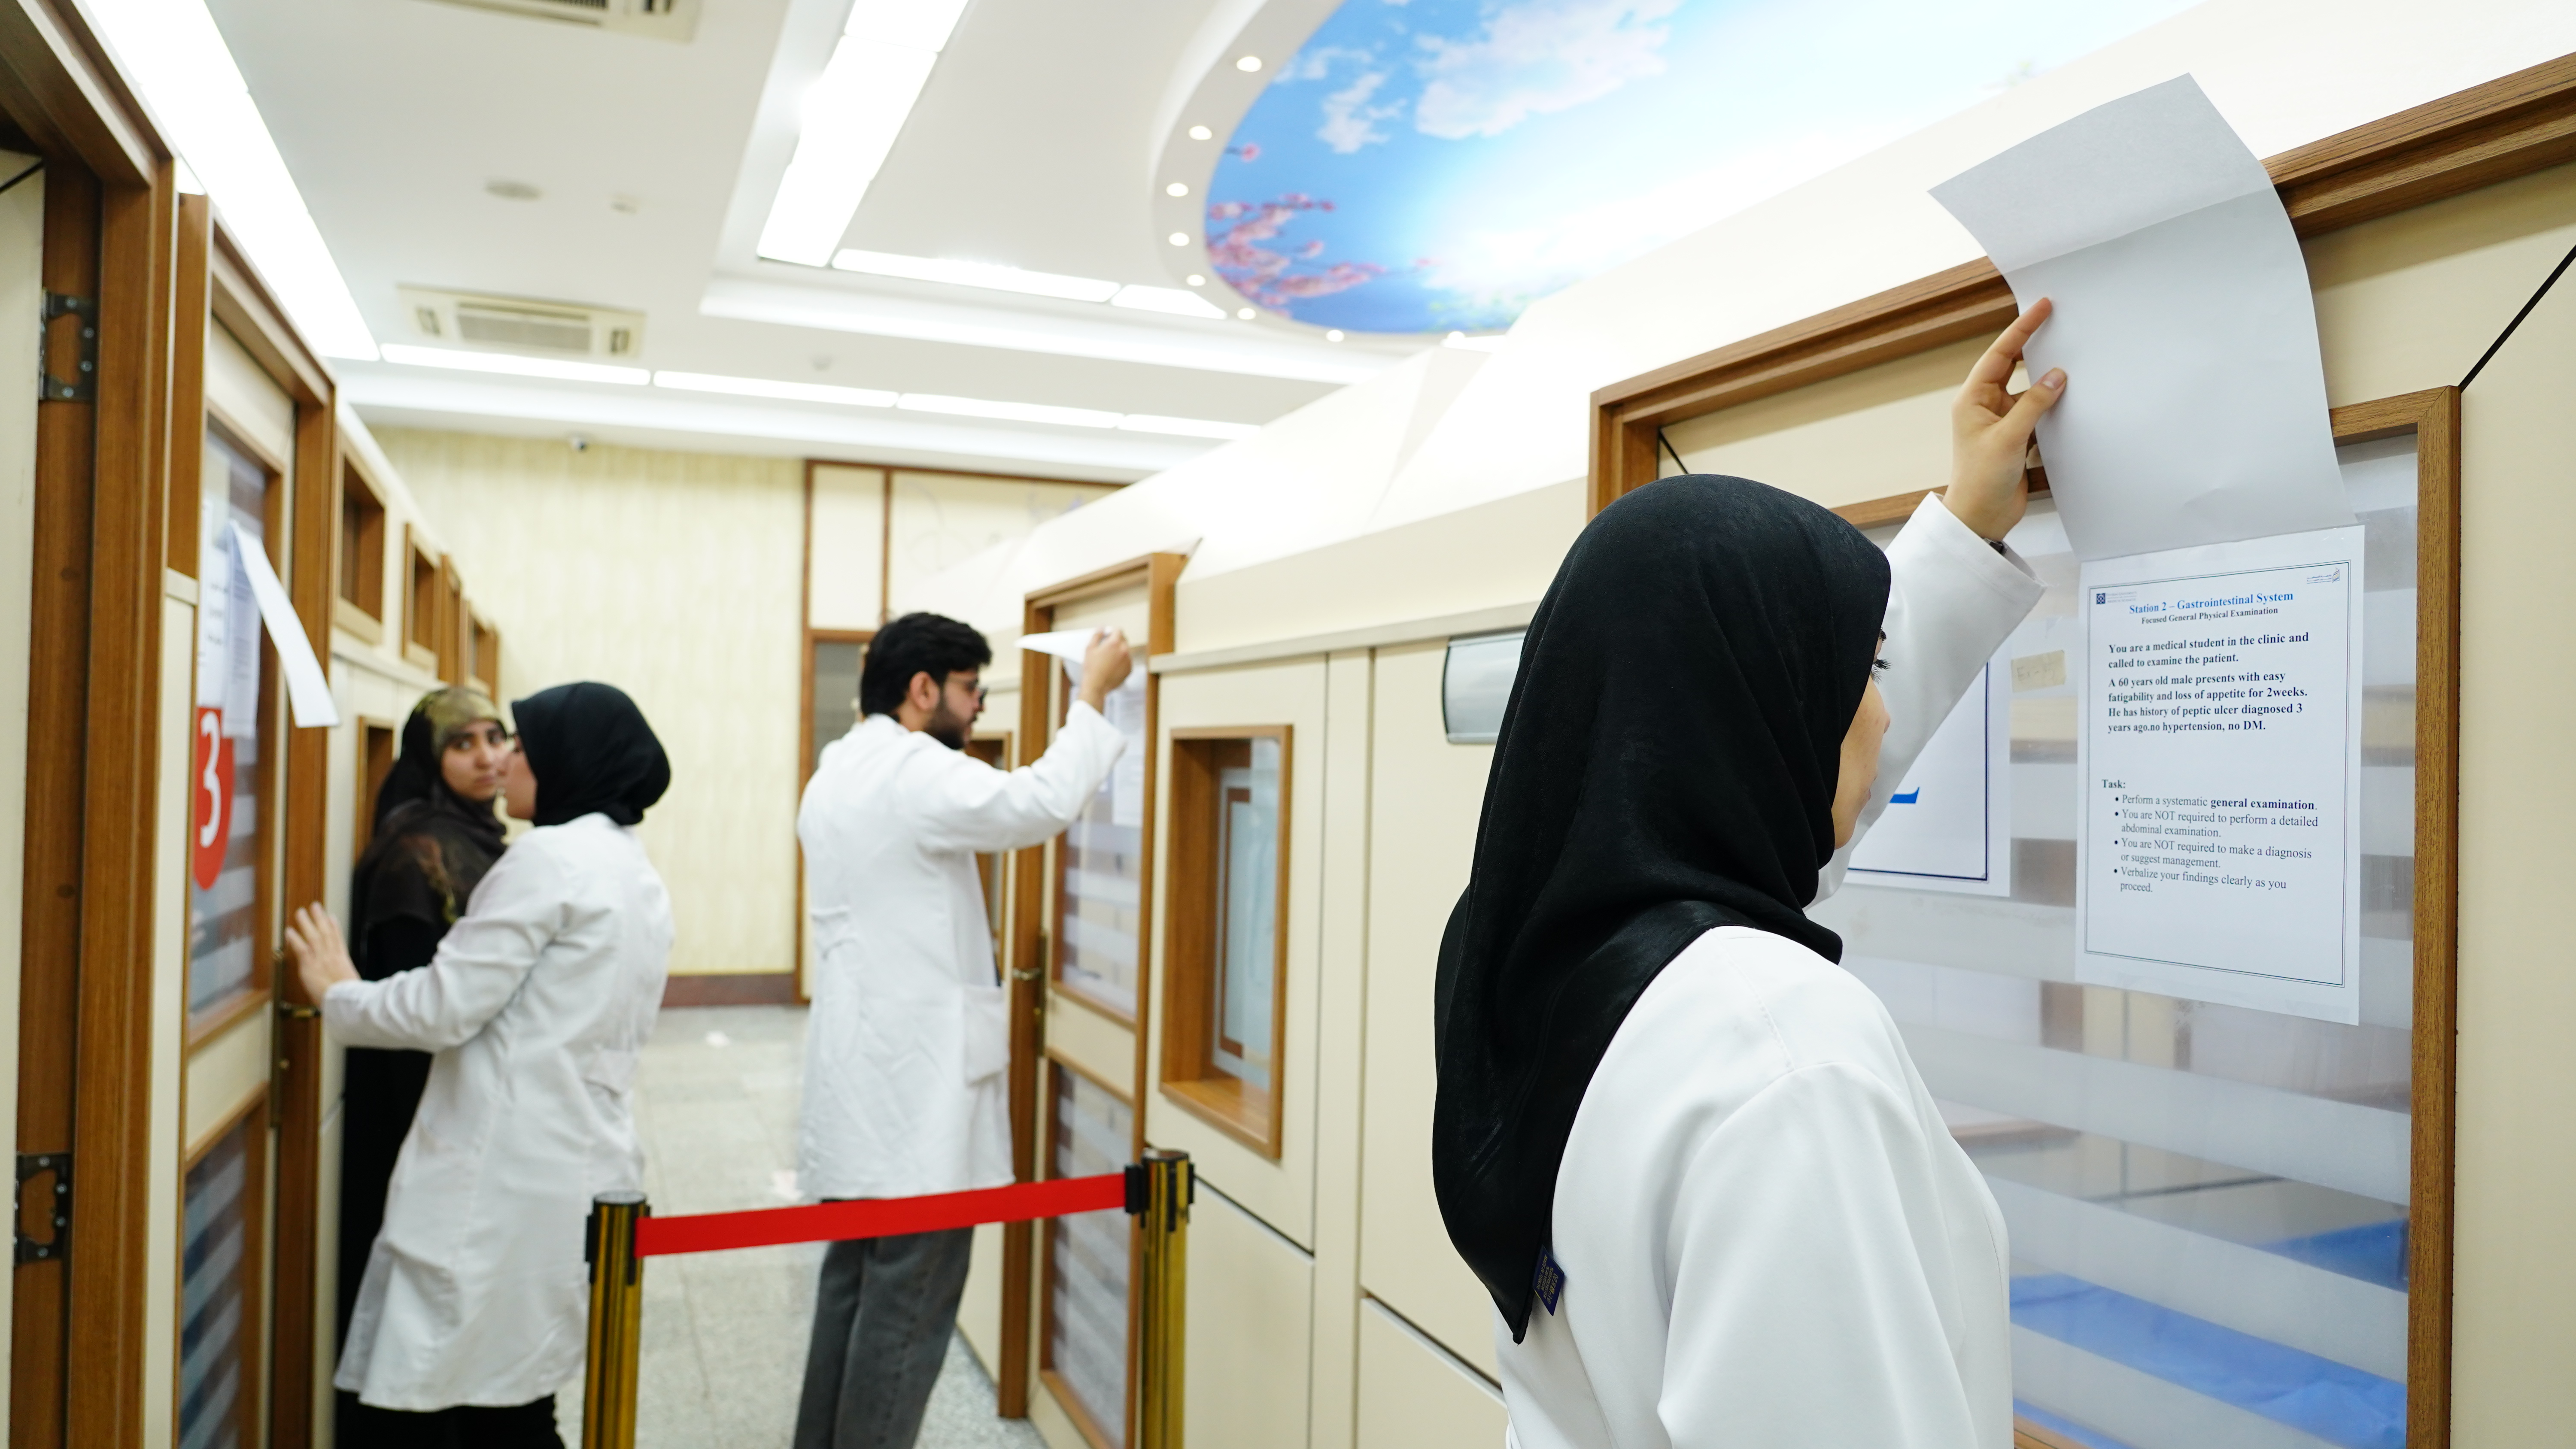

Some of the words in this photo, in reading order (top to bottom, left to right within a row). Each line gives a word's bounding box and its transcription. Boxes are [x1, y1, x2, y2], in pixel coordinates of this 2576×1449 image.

[2129, 603, 2160, 614] Station
[2161, 602, 2167, 611] 2
[2177, 594, 2254, 610] Gastrointestinal
[2256, 593, 2294, 605] System
[2142, 615, 2167, 624] Focused
[2168, 612, 2197, 622] General
[2199, 610, 2229, 621] Physical
[2230, 607, 2278, 617] Examination
[2108, 644, 2127, 654] You
[2152, 639, 2187, 651] medical
[2189, 638, 2225, 649] student
[2227, 637, 2237, 646] in
[2239, 635, 2255, 646] the
[2257, 633, 2286, 644] clinic
[2288, 631, 2309, 643] and
[2108, 658, 2134, 669] called
[2136, 659, 2145, 667] to
[2147, 656, 2183, 667] examine
[2185, 655, 2200, 664] the
[2202, 653, 2239, 666] patient.
[2108, 678, 2116, 687] A
[2118, 677, 2129, 687] 60
[2131, 679, 2153, 689] years
[2155, 675, 2169, 685] old
[2171, 674, 2193, 685] male
[2195, 674, 2236, 686] presents
[2238, 671, 2260, 682] with
[2263, 673, 2286, 683] easy
[2108, 692, 2154, 704] fatigability
[2156, 691, 2173, 700] and
[2175, 690, 2192, 700] loss
[2194, 689, 2205, 700] of
[2206, 688, 2246, 701] appetite
[2248, 688, 2264, 698] for
[2266, 686, 2308, 697] 2weeks.
[2108, 707, 2121, 717] He
[2123, 707, 2138, 717] has
[2140, 707, 2169, 718] history
[2171, 706, 2181, 715] of
[2182, 705, 2211, 718] peptic
[2214, 705, 2239, 715] ulcer
[2241, 703, 2293, 716] diagnosed
[2296, 703, 2303, 713] 3
[2108, 724, 2131, 734] years
[2162, 721, 2225, 734] hypertension,
[2243, 720, 2266, 730] DM.
[199, 711, 222, 848] 3
[2101, 779, 2126, 789] Task:
[2122, 794, 2154, 804] Perform
[2162, 796, 2208, 807] systematic
[2210, 798, 2248, 809] general
[2250, 799, 2318, 810] examination.
[2122, 809, 2139, 819] You
[2154, 810, 2176, 821] NOT
[2178, 812, 2215, 824] required
[2218, 814, 2227, 823] to
[2230, 813, 2268, 825] perform
[2279, 815, 2318, 827] detailed
[2121, 823, 2162, 834] abdominal
[2164, 826, 2221, 837] examination.
[2121, 837, 2138, 848] You
[2154, 840, 2175, 850] NOT
[2177, 842, 2215, 854] required
[2217, 845, 2227, 853] to
[2229, 844, 2255, 855] make
[2265, 846, 2312, 859] diagnosis
[2131, 855, 2160, 865] suggest
[2162, 857, 2221, 868] management.
[2120, 866, 2158, 879] Verbalize
[2160, 872, 2180, 882] your
[2182, 871, 2219, 885] findings
[2221, 874, 2253, 888] clearly
[2268, 880, 2287, 890] you
[2120, 882, 2153, 892] proceed.
